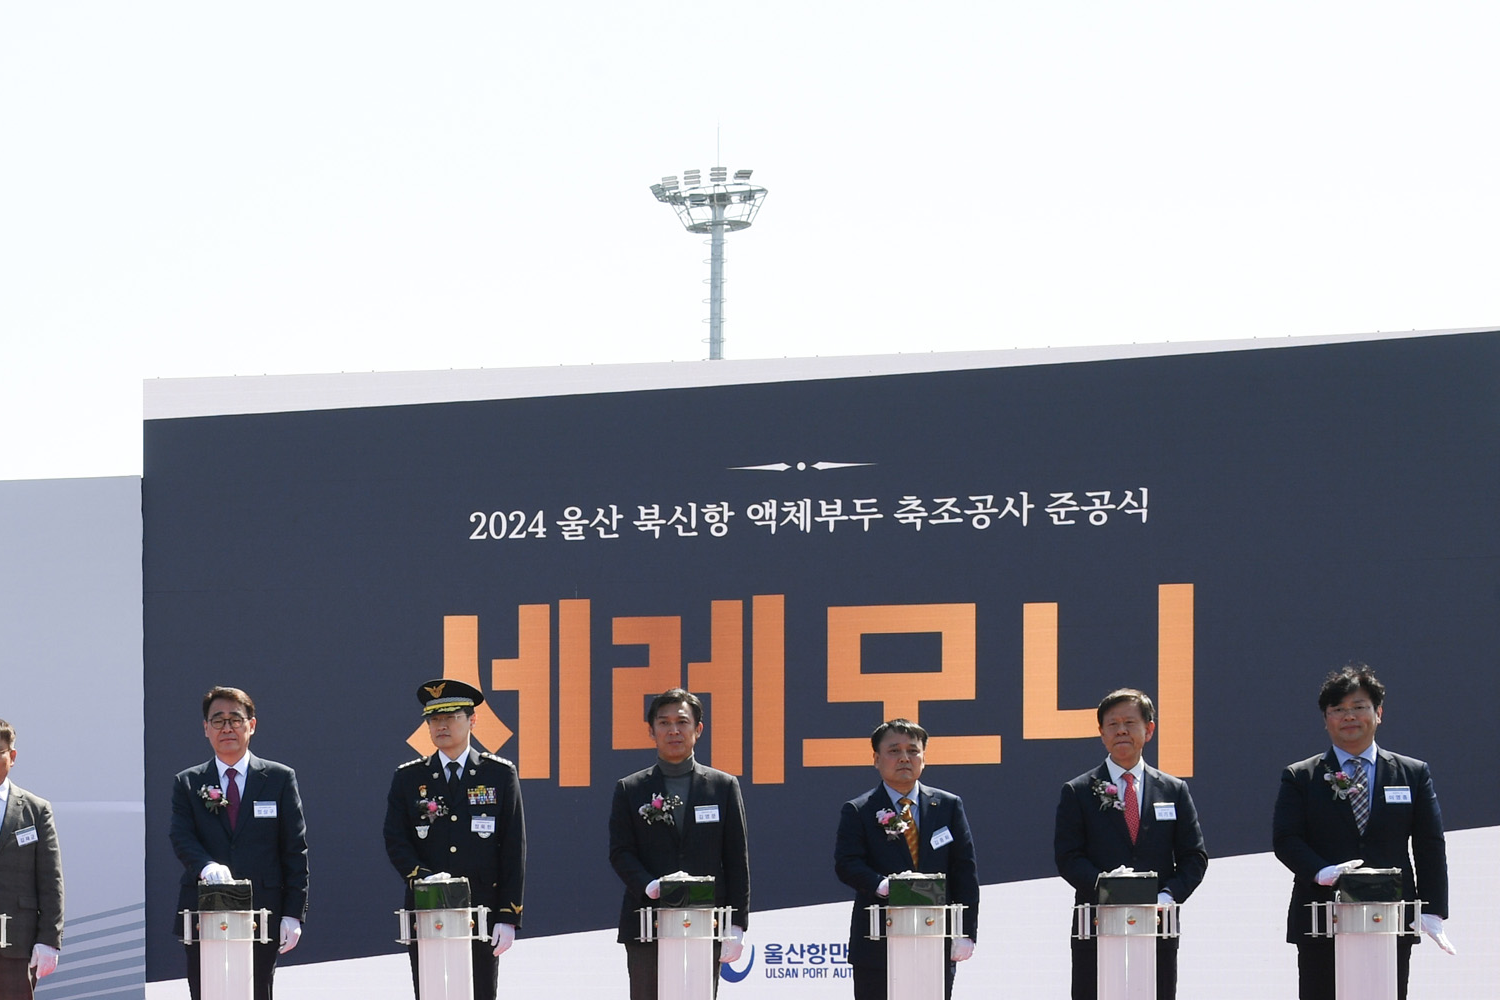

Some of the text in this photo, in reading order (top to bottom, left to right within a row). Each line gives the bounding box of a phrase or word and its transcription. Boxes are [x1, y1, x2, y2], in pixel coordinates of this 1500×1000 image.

[470, 487, 1149, 541] 2024 울산 북신항 액체부두 축조공사 준공식
[406, 583, 1195, 787] 세레모니
[763, 943, 849, 965] 울산항만
[765, 967, 799, 979] ULSAN
[802, 967, 829, 979] PORT
